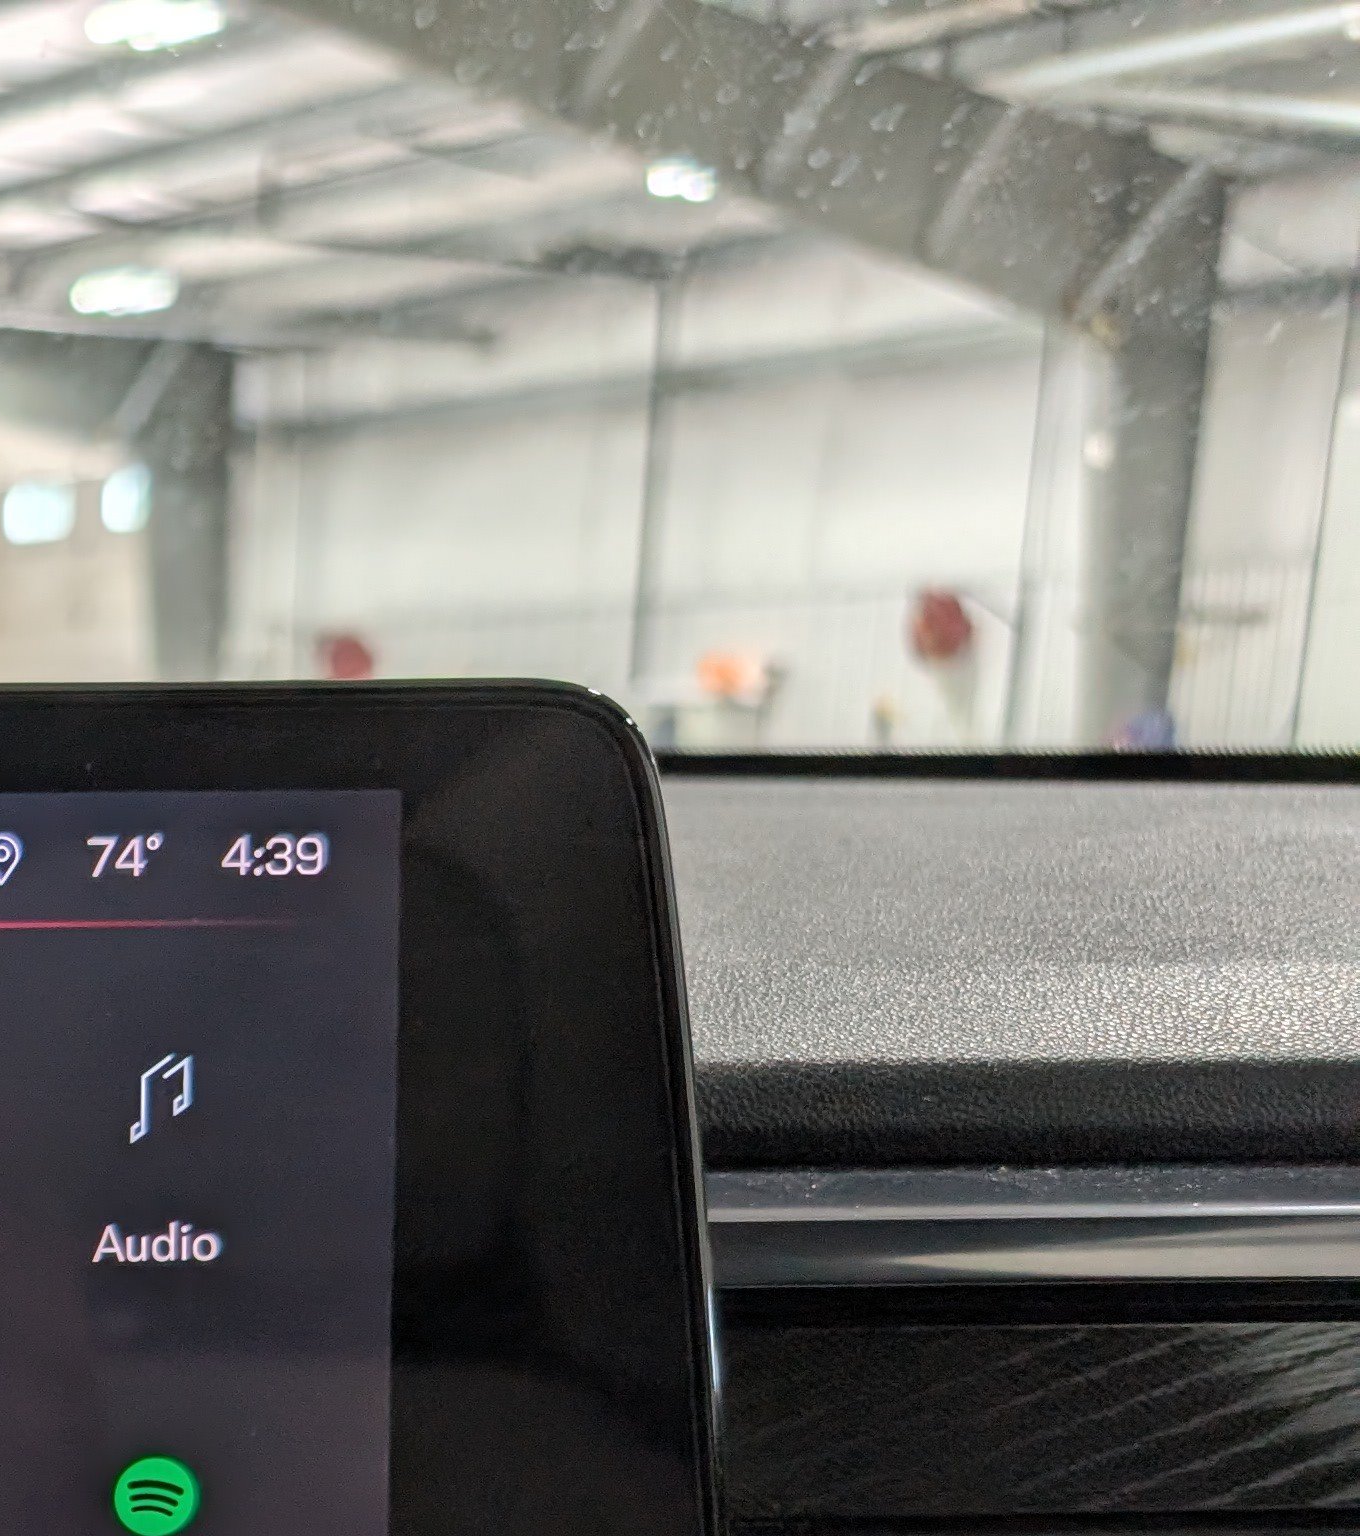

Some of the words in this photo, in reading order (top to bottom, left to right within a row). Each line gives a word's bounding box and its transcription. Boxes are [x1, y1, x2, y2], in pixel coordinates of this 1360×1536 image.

[87, 833, 163, 877] 74°
[222, 834, 328, 876] 4:39
[93, 1222, 221, 1262] Audio
